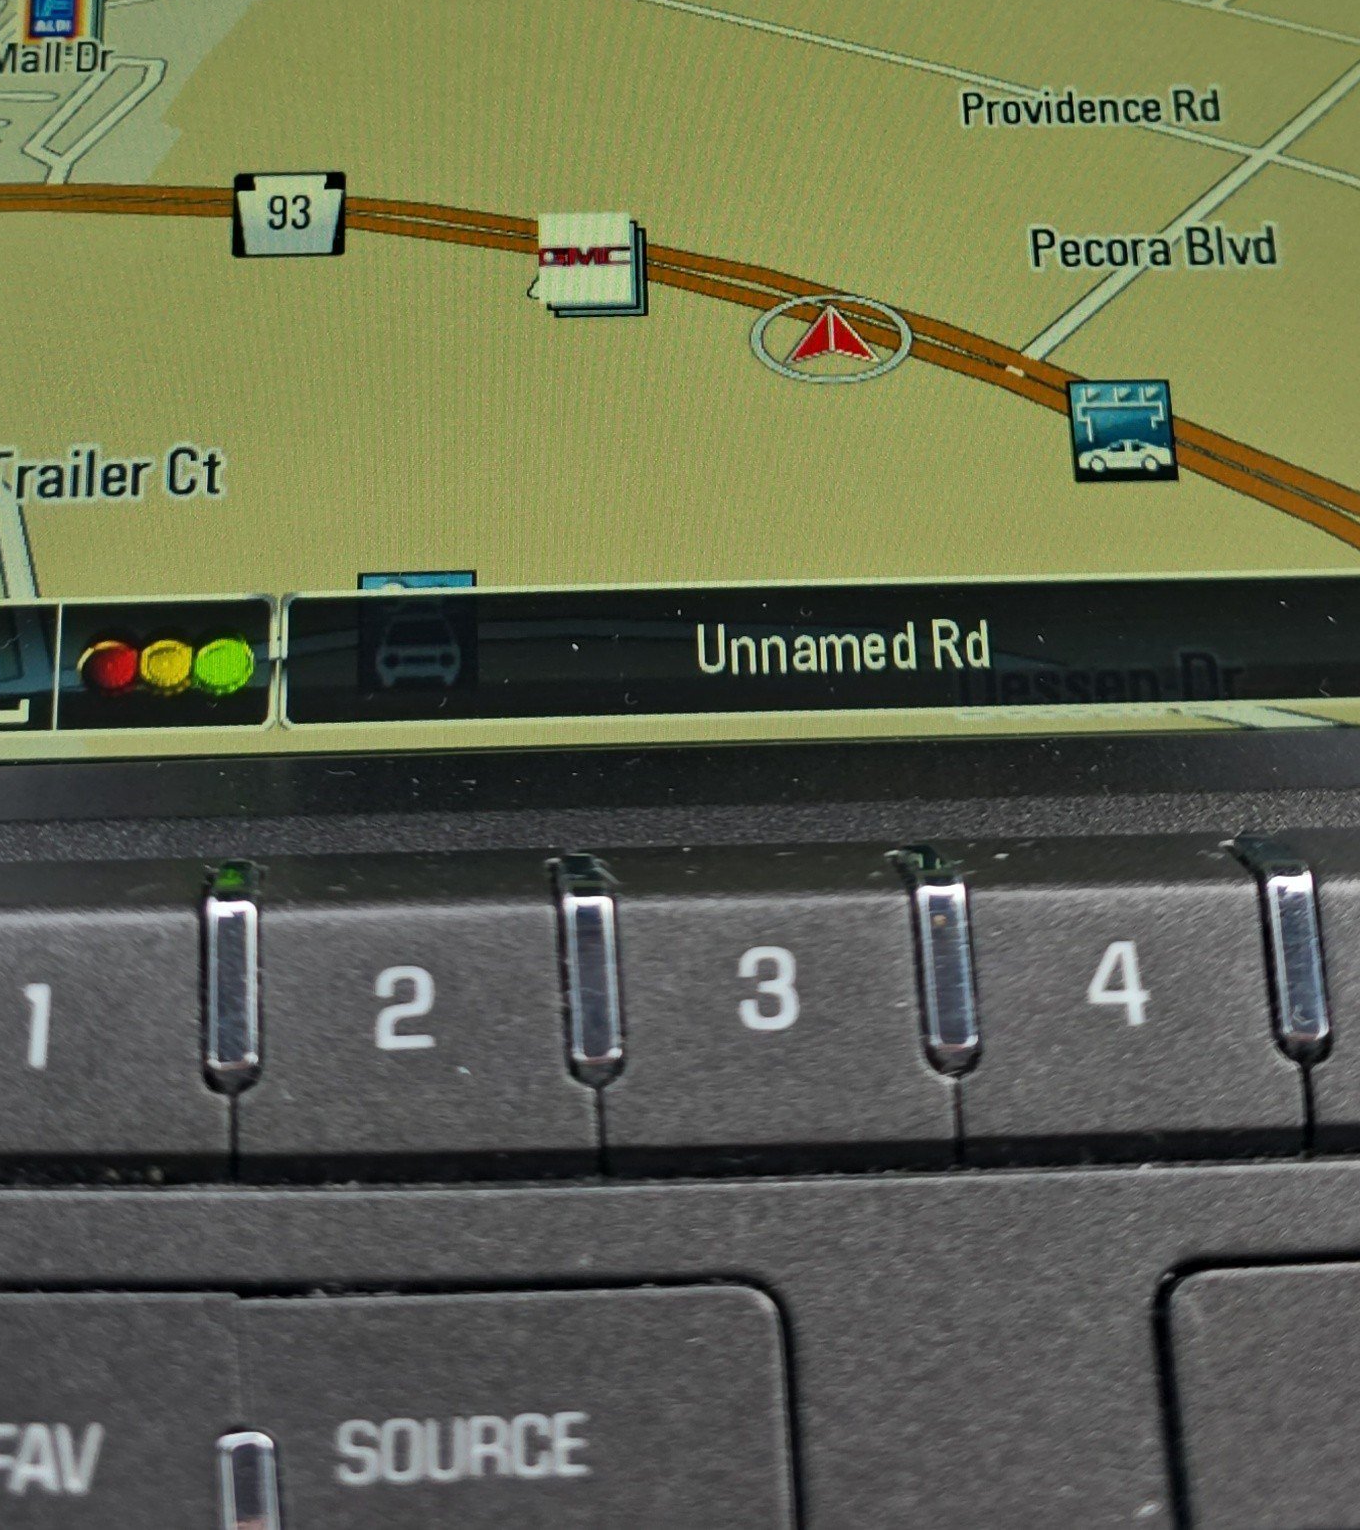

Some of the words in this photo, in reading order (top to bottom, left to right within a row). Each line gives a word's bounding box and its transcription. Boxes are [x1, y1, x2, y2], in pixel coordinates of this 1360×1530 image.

[76, 41, 113, 73] Dr
[962, 92, 1161, 126] Providence
[1173, 89, 1220, 122] Rd
[268, 195, 311, 231] 93
[1032, 230, 1172, 267] Pecora
[1186, 226, 1277, 265] Blvd
[166, 446, 222, 496] Ct
[697, 624, 917, 675] Unnamed
[933, 619, 991, 669] Rd
[373, 965, 436, 1051] 2
[736, 946, 800, 1031] 3
[1086, 940, 1151, 1026] 4
[25, 983, 52, 1070] 1
[335, 1410, 592, 1486] SOURCE
